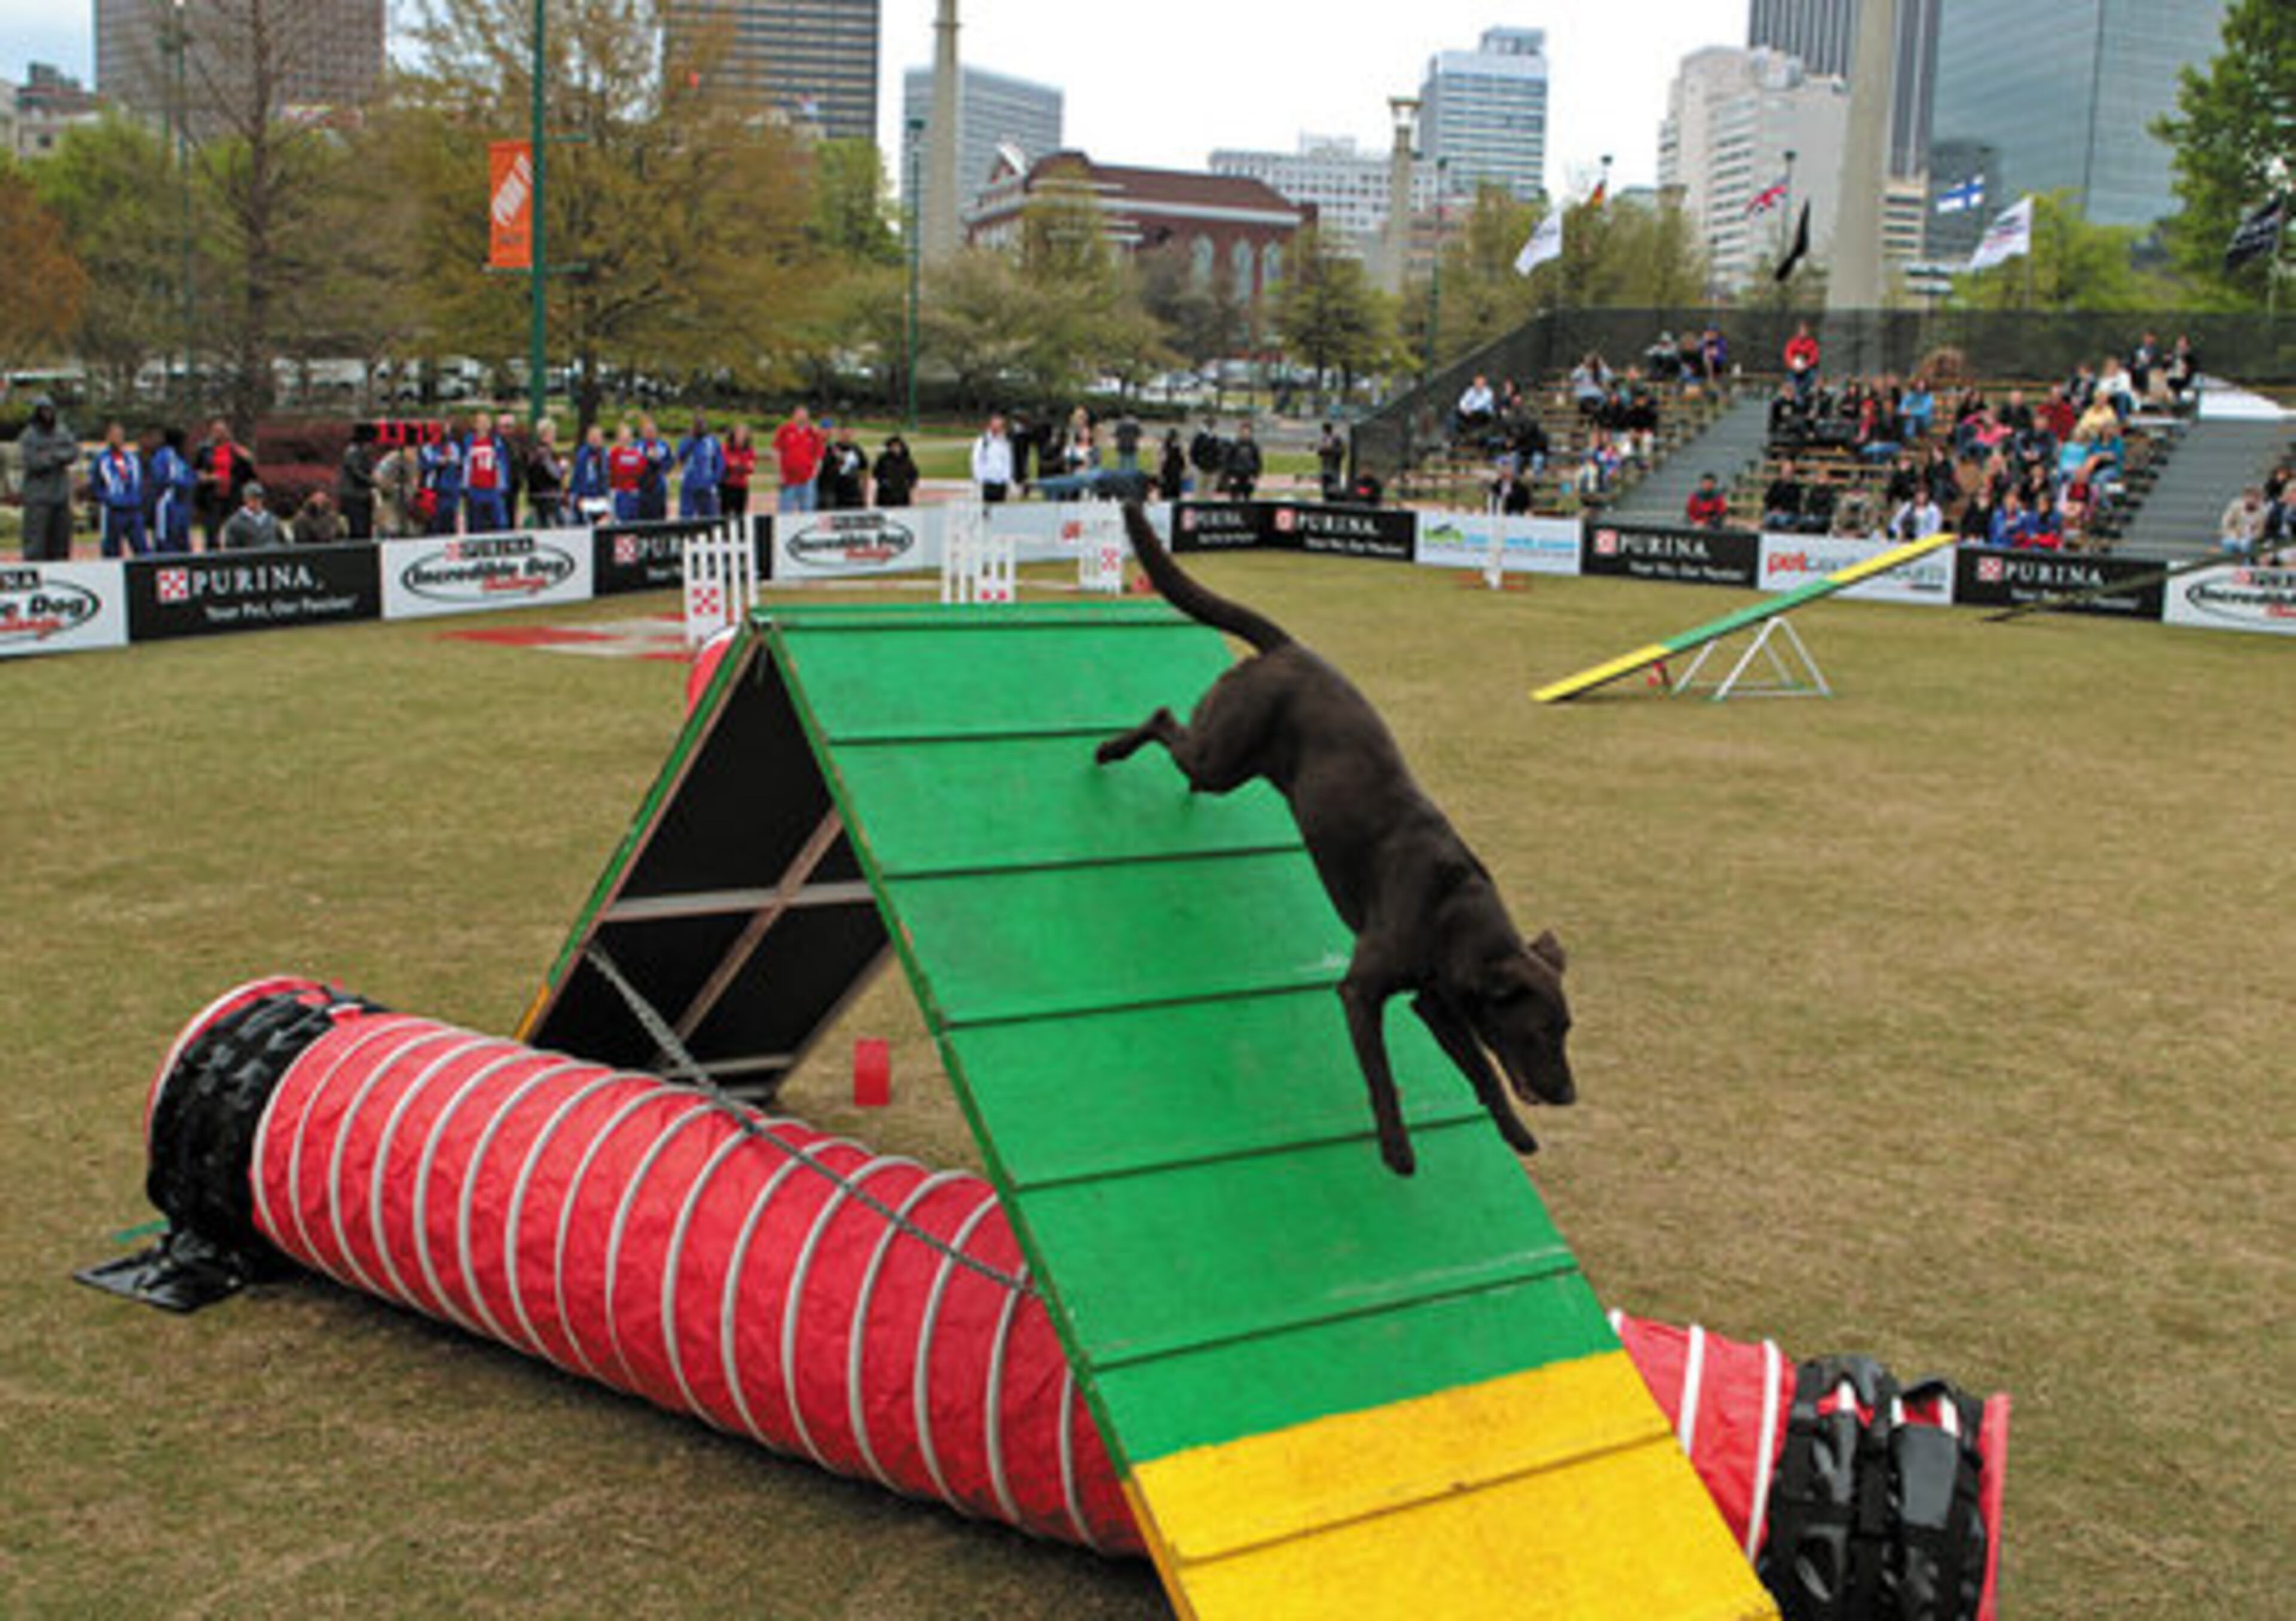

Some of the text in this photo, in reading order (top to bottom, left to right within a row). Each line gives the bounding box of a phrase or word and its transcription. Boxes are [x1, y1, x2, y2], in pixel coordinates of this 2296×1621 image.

[1619, 533, 1710, 558] PURINA
[192, 564, 316, 596] PURINA
[2005, 561, 2104, 587] PURINA
[31, 594, 84, 624] Dog
